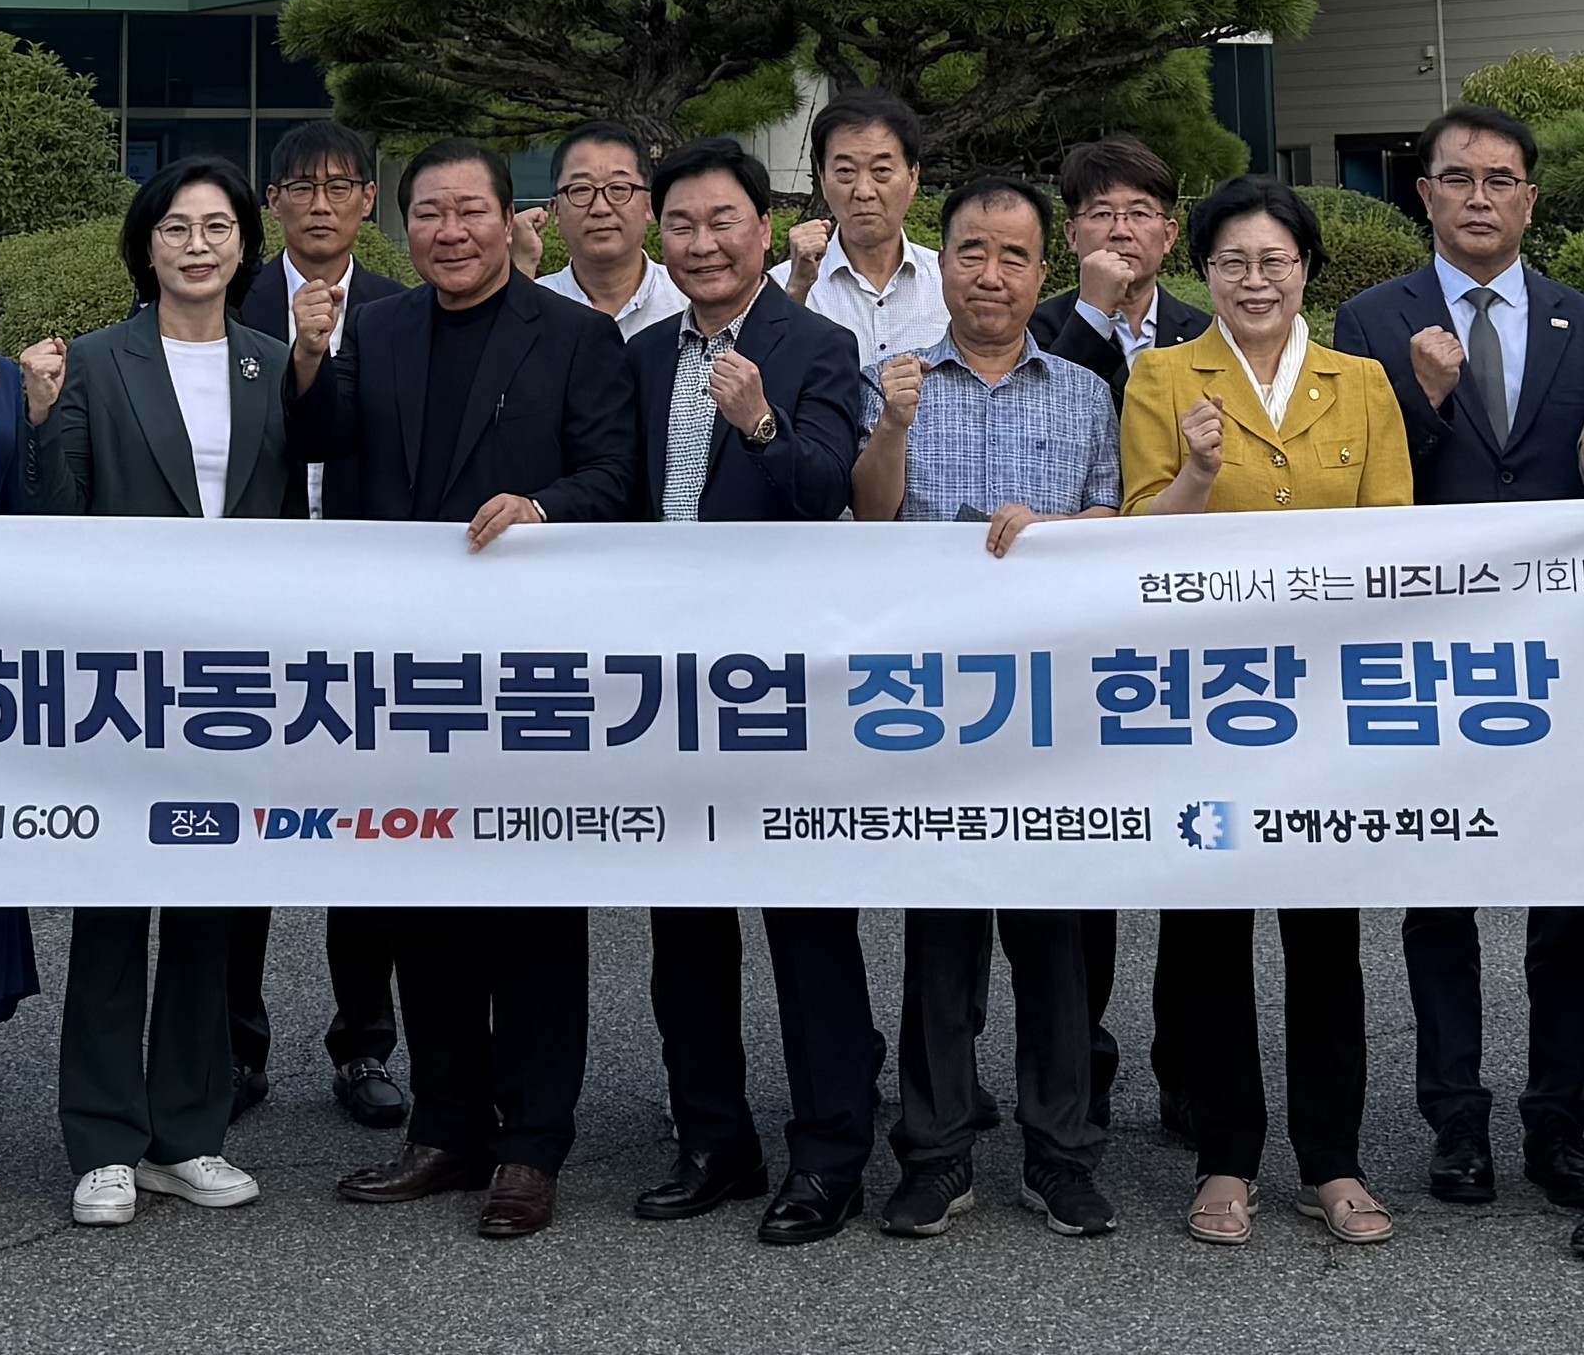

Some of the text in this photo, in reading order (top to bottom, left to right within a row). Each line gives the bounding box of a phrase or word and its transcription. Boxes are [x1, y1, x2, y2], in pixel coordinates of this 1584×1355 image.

[1138, 567, 1276, 604] 현장에서
[1286, 564, 1355, 602] 찾는
[1365, 562, 1501, 600] 비즈니스
[847, 651, 1053, 751] 정기
[1091, 645, 1307, 747] 현장
[1340, 640, 1560, 747] 탐방
[171, 809, 220, 837] 장소
[473, 804, 666, 844] 디케이락(주)
[762, 805, 1499, 844] 김해자동차부품기업협의회 김해상공회의소
